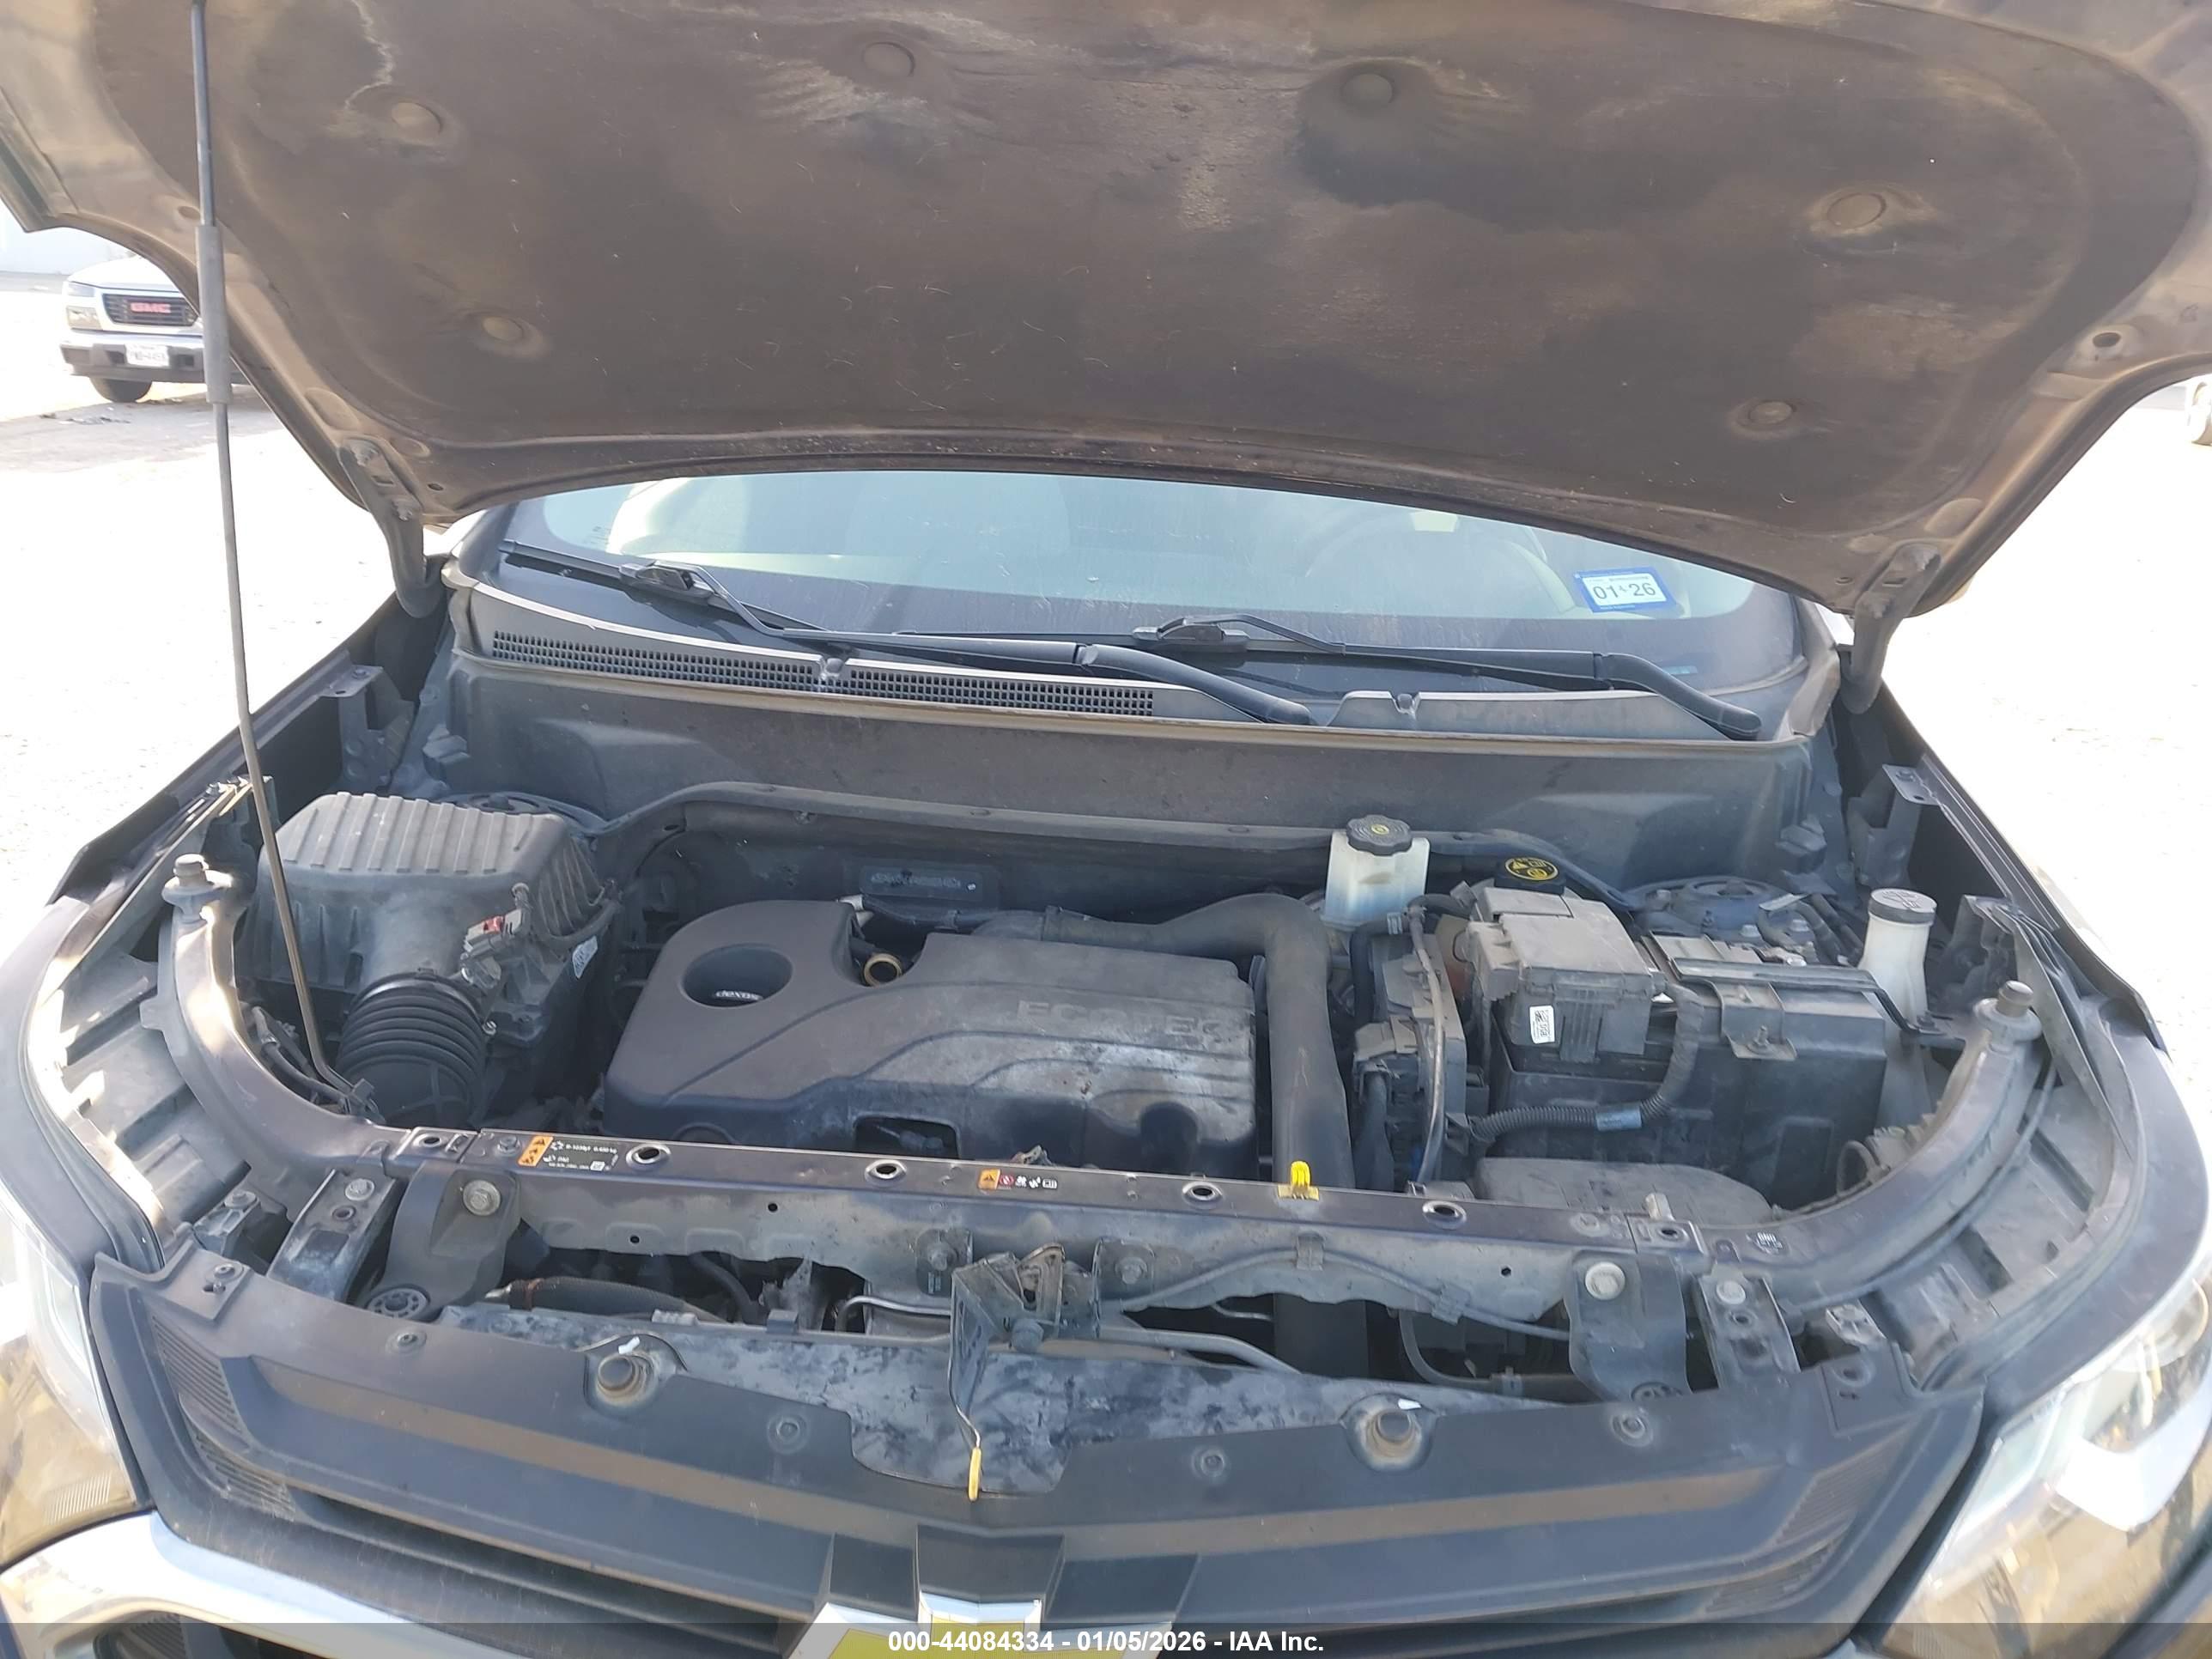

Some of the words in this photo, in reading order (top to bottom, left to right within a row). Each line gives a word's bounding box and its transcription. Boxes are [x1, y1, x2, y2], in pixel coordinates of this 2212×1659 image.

[130, 301, 172, 314] GMC
[1592, 585, 1620, 600] 01
[1627, 582, 1656, 597] 26
